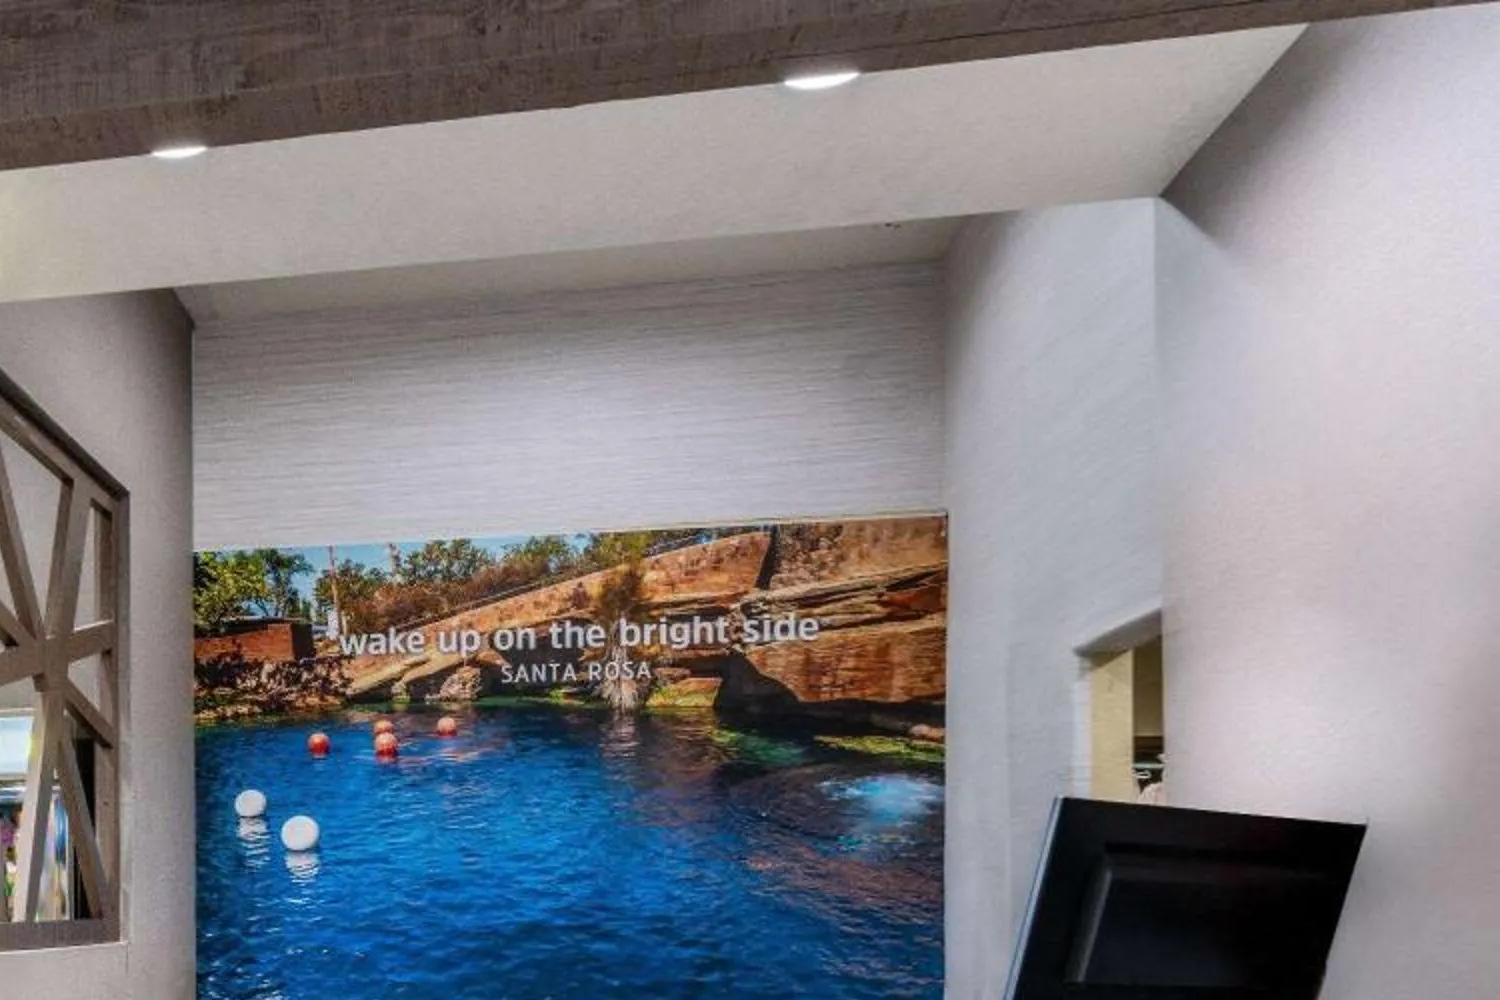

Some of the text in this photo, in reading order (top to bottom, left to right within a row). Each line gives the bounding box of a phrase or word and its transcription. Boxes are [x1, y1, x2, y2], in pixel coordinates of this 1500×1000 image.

[340, 613, 819, 660] wake up on the bright side
[501, 661, 651, 684] SANTA ROSA
